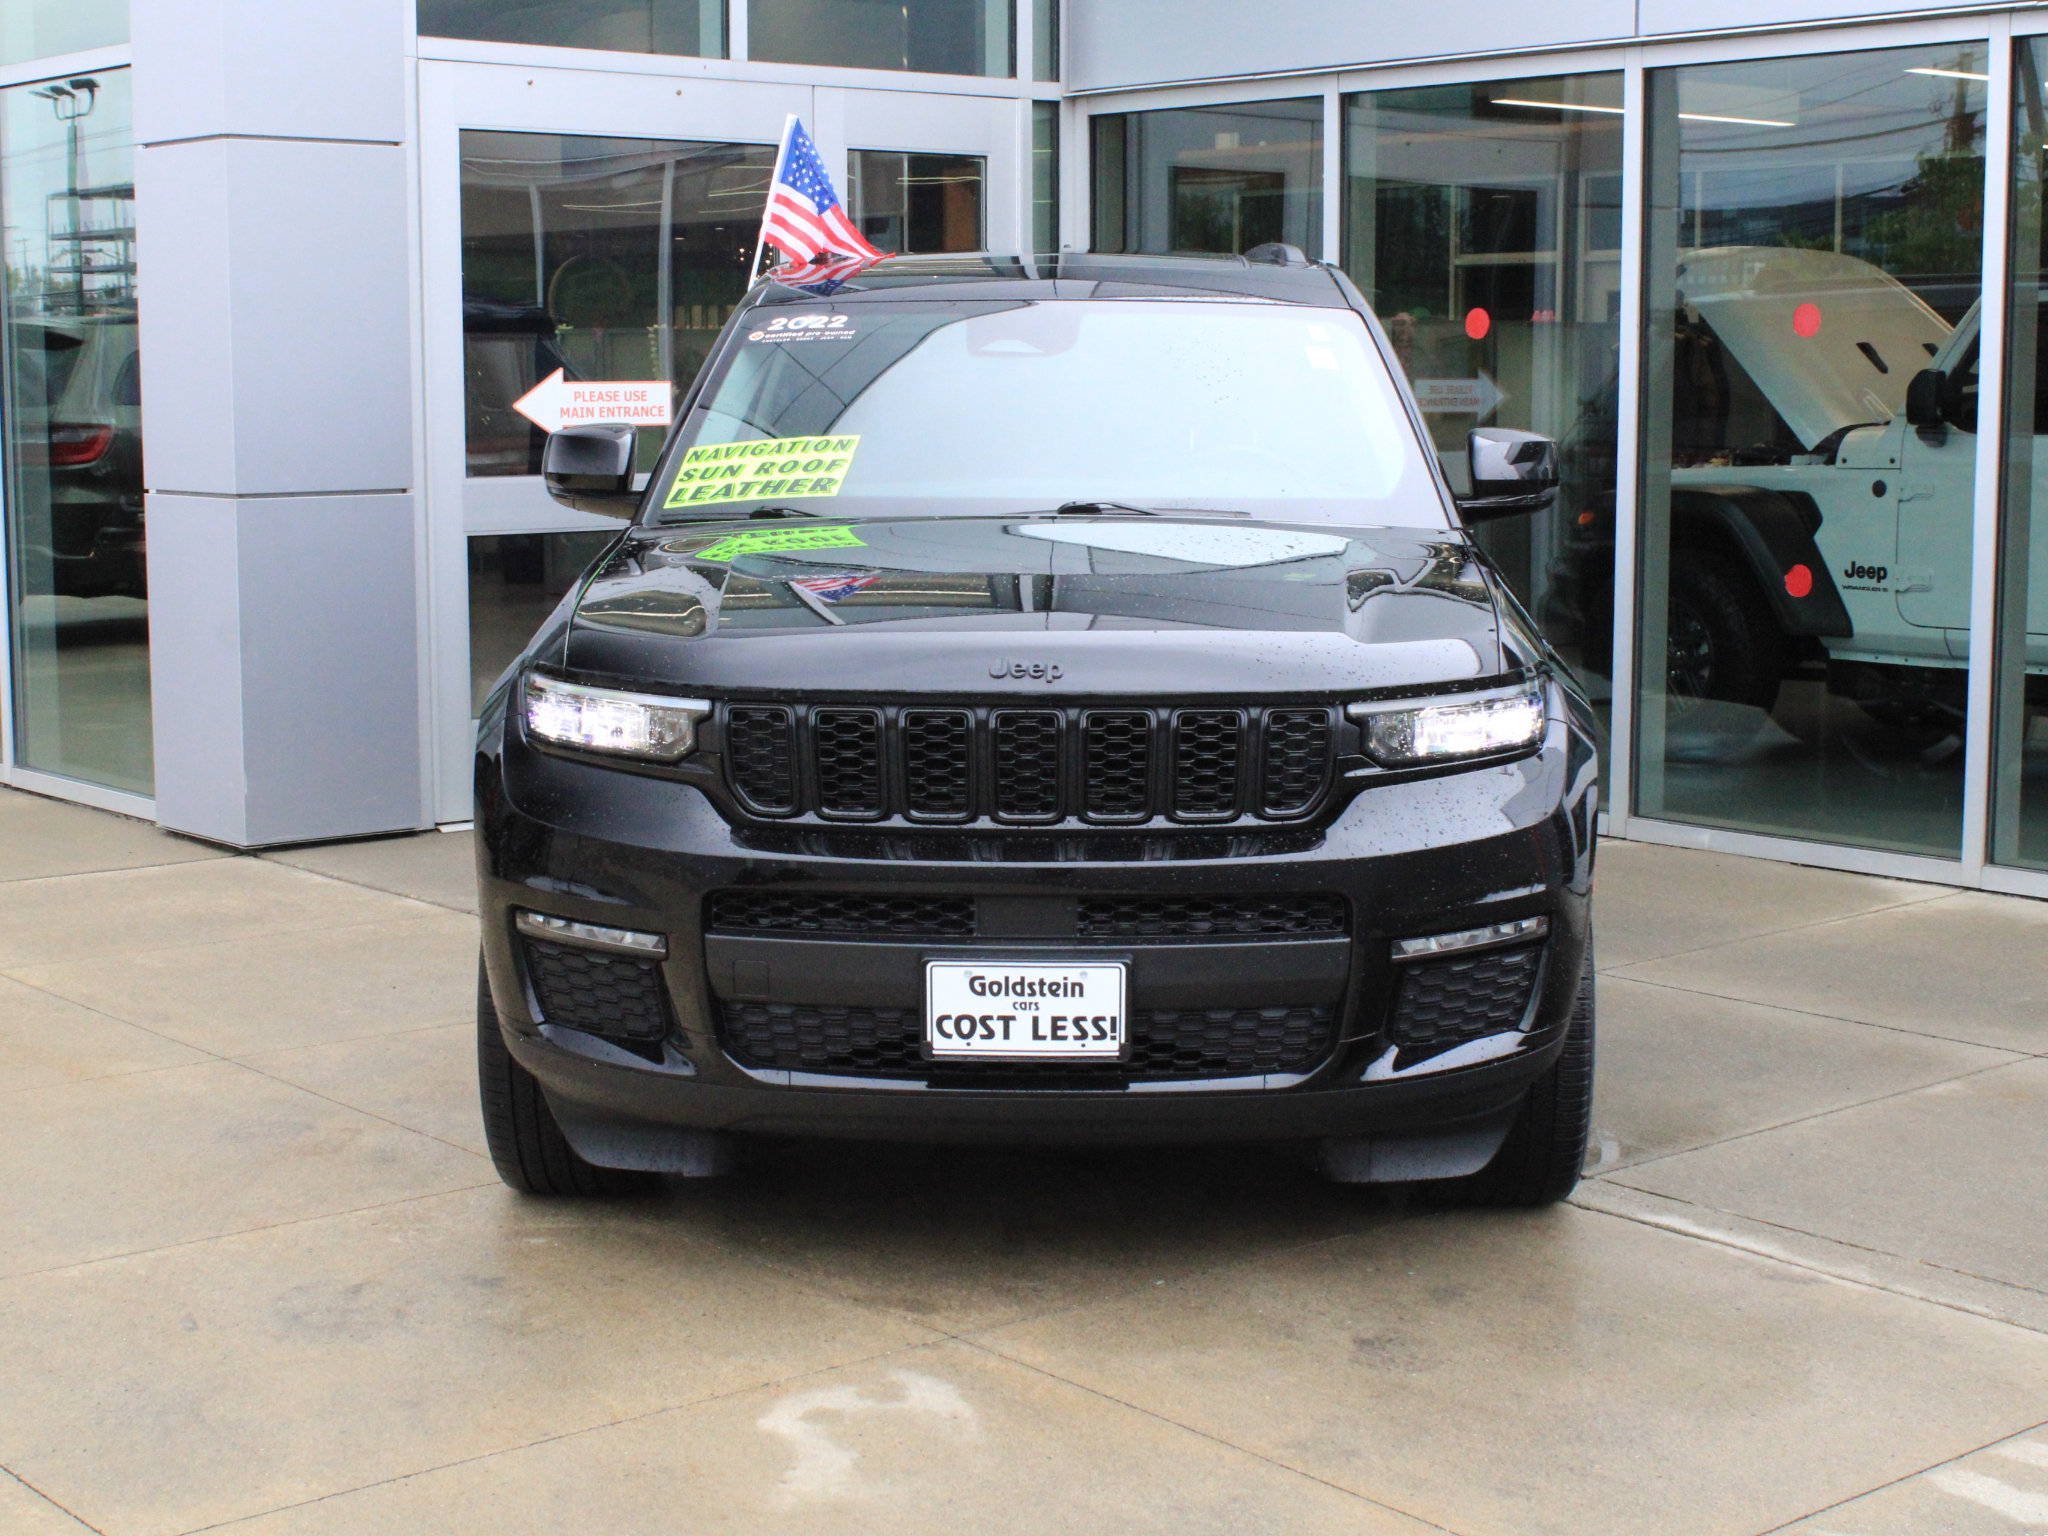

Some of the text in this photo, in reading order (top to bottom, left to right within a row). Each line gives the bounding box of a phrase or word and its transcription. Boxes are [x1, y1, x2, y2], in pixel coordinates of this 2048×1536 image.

[767, 315, 848, 330] 2022
[573, 390, 648, 402] PLEASE USE
[560, 405, 665, 418] MAIN ENTRANCE
[686, 438, 855, 463] NAVIGATION
[678, 458, 847, 483] SUN ROOF
[669, 478, 838, 503] LEATHER
[1844, 561, 1888, 583] Jeep
[989, 659, 1064, 684] Jeep
[969, 975, 1085, 998] Goldstein
[1012, 1001, 1040, 1011] cars
[936, 1014, 1117, 1041] COST LESS!
